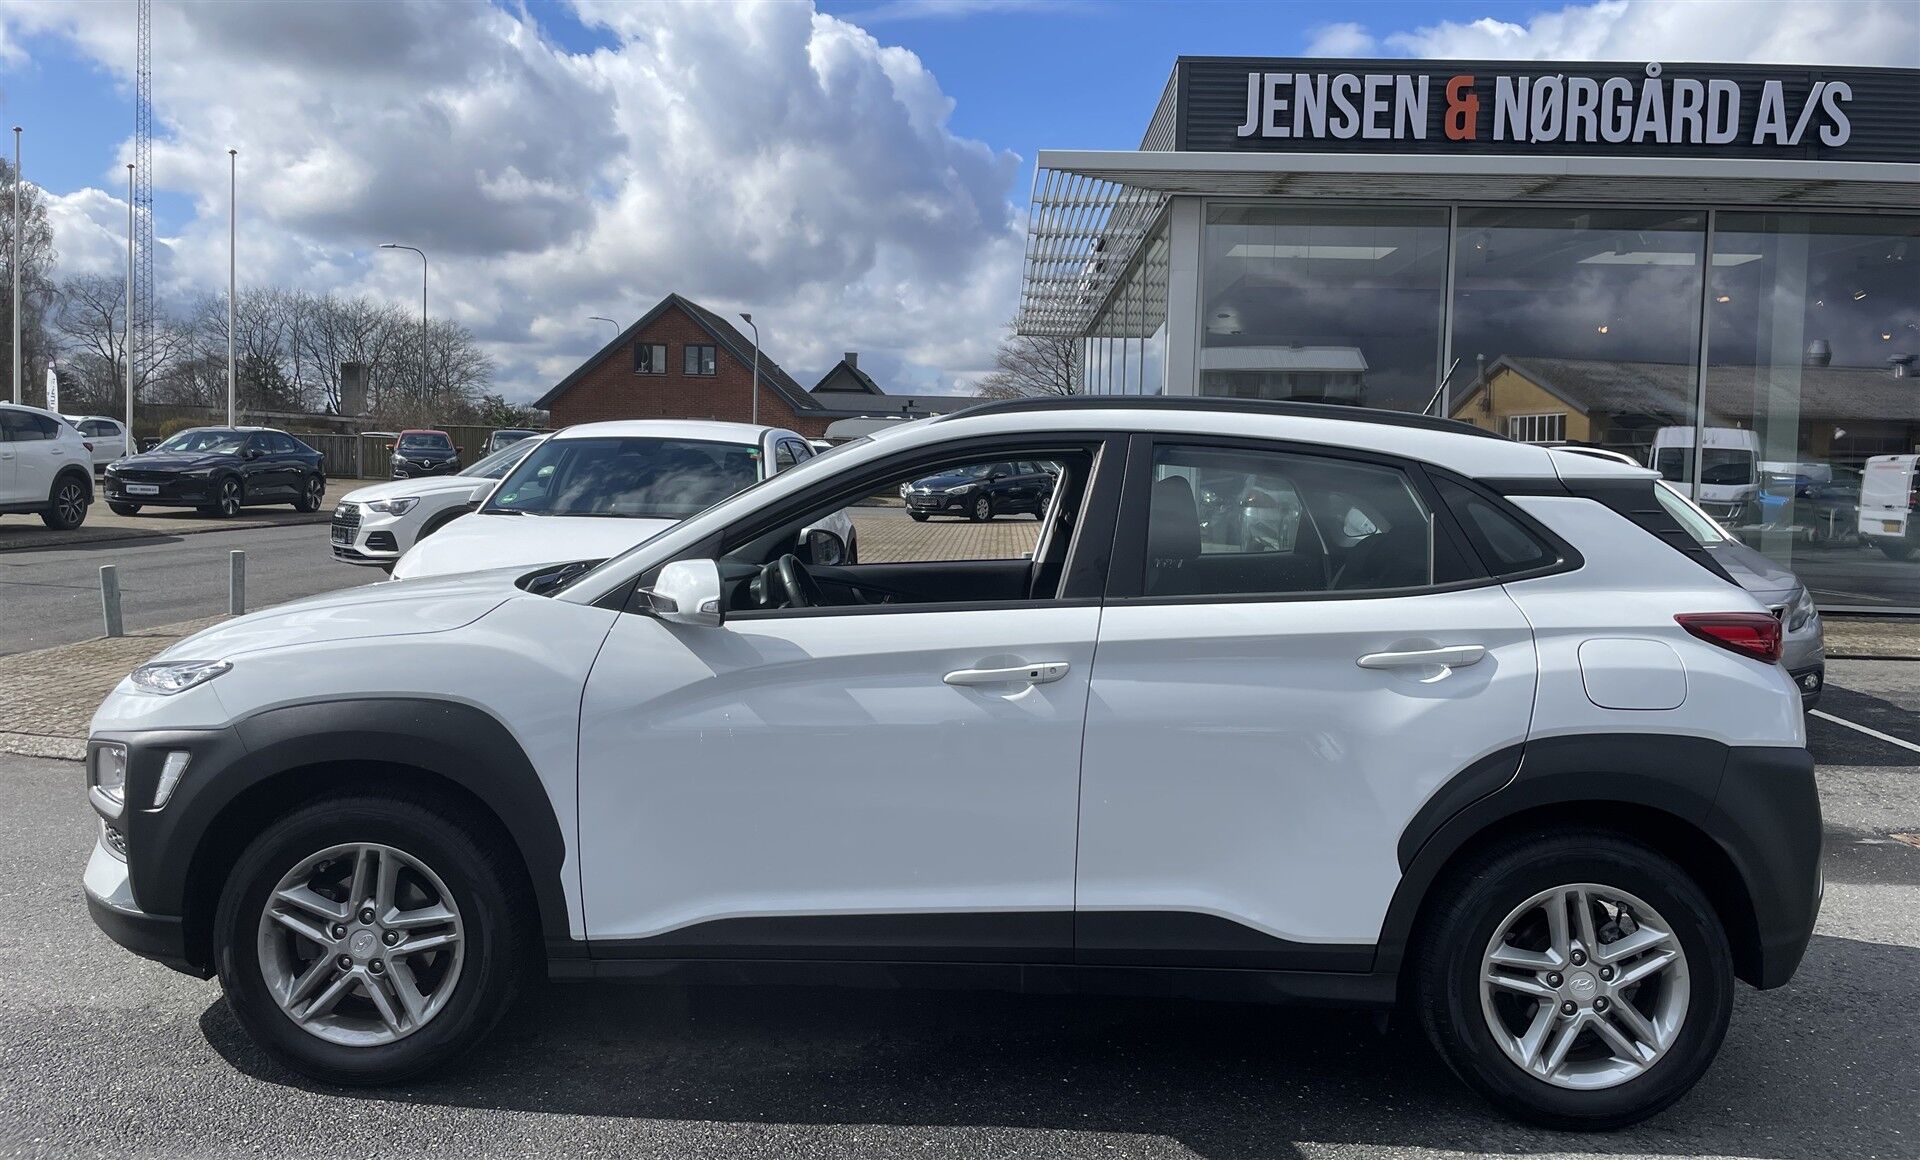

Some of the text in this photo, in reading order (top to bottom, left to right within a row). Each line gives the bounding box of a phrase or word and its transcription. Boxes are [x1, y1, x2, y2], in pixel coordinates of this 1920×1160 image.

[1237, 62, 1853, 147] JENSEN & NØRGÅRD A/S
